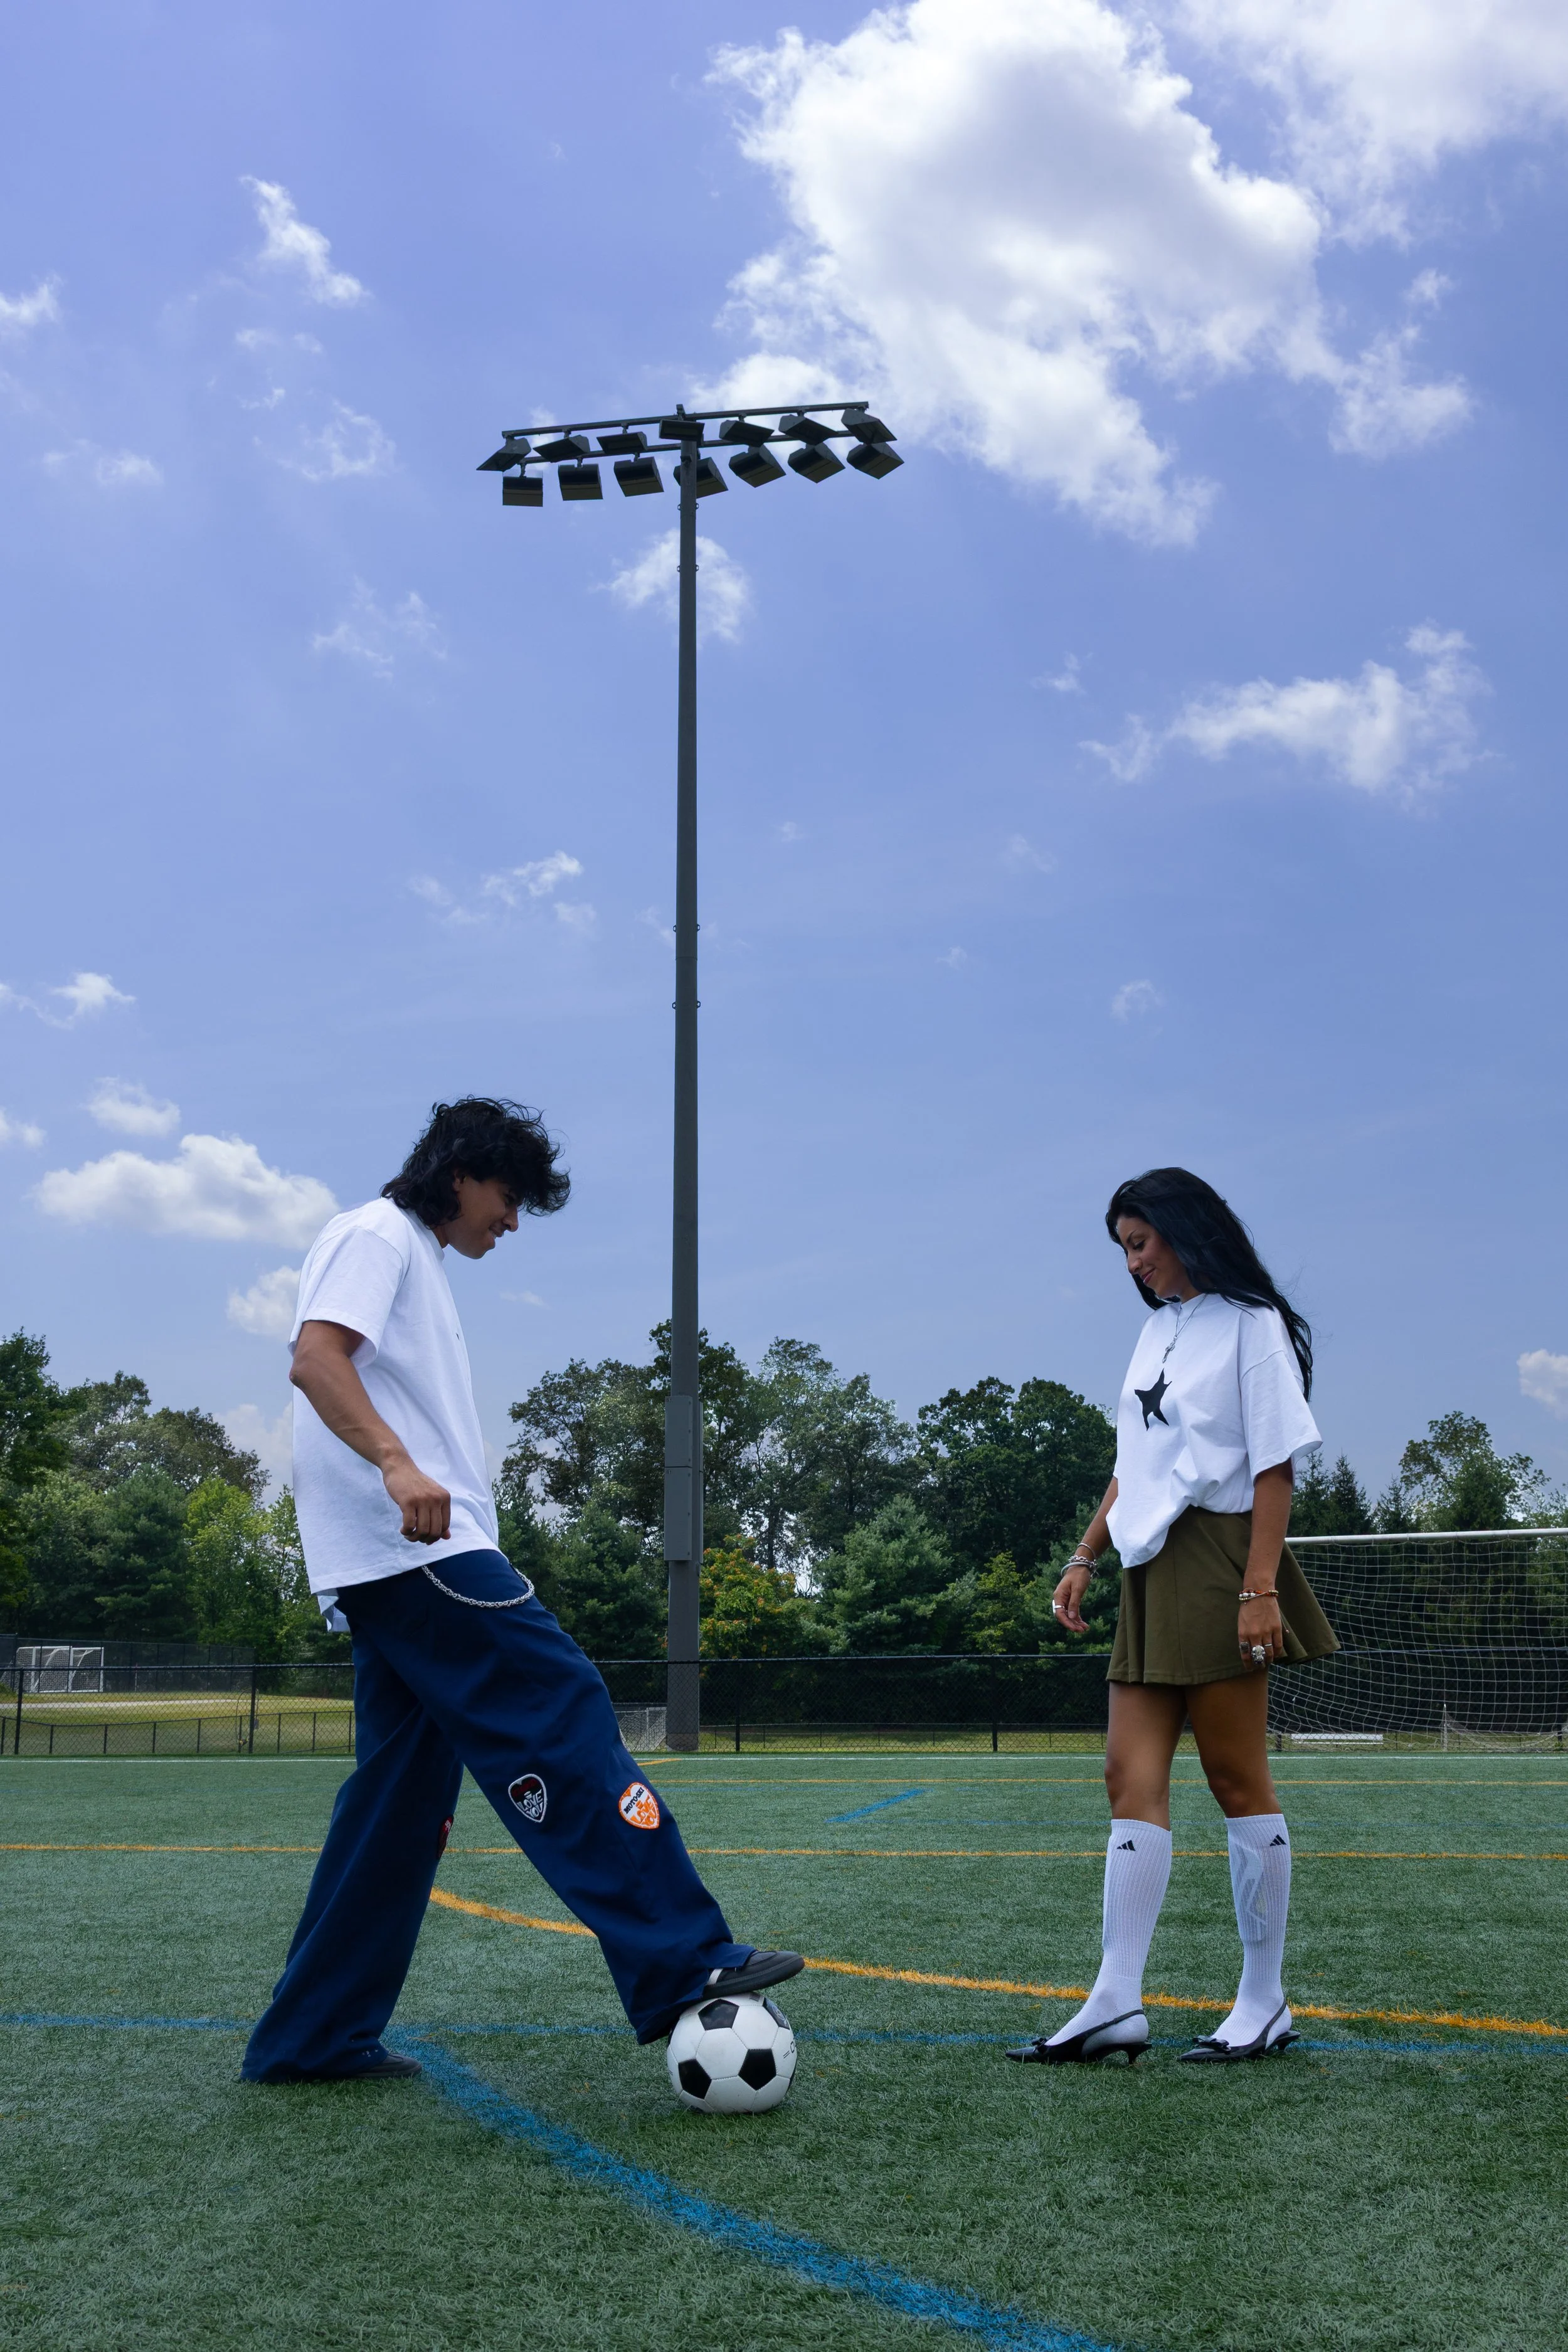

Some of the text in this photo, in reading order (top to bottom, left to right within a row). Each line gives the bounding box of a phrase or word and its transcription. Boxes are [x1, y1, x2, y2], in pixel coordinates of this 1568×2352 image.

[516, 1788, 543, 1811] LOVE
[526, 1802, 543, 1818] YOU
[623, 1786, 645, 1814] MOTO-SKI
[630, 1794, 654, 1823] LOVE
[641, 1807, 657, 1826] YOU
